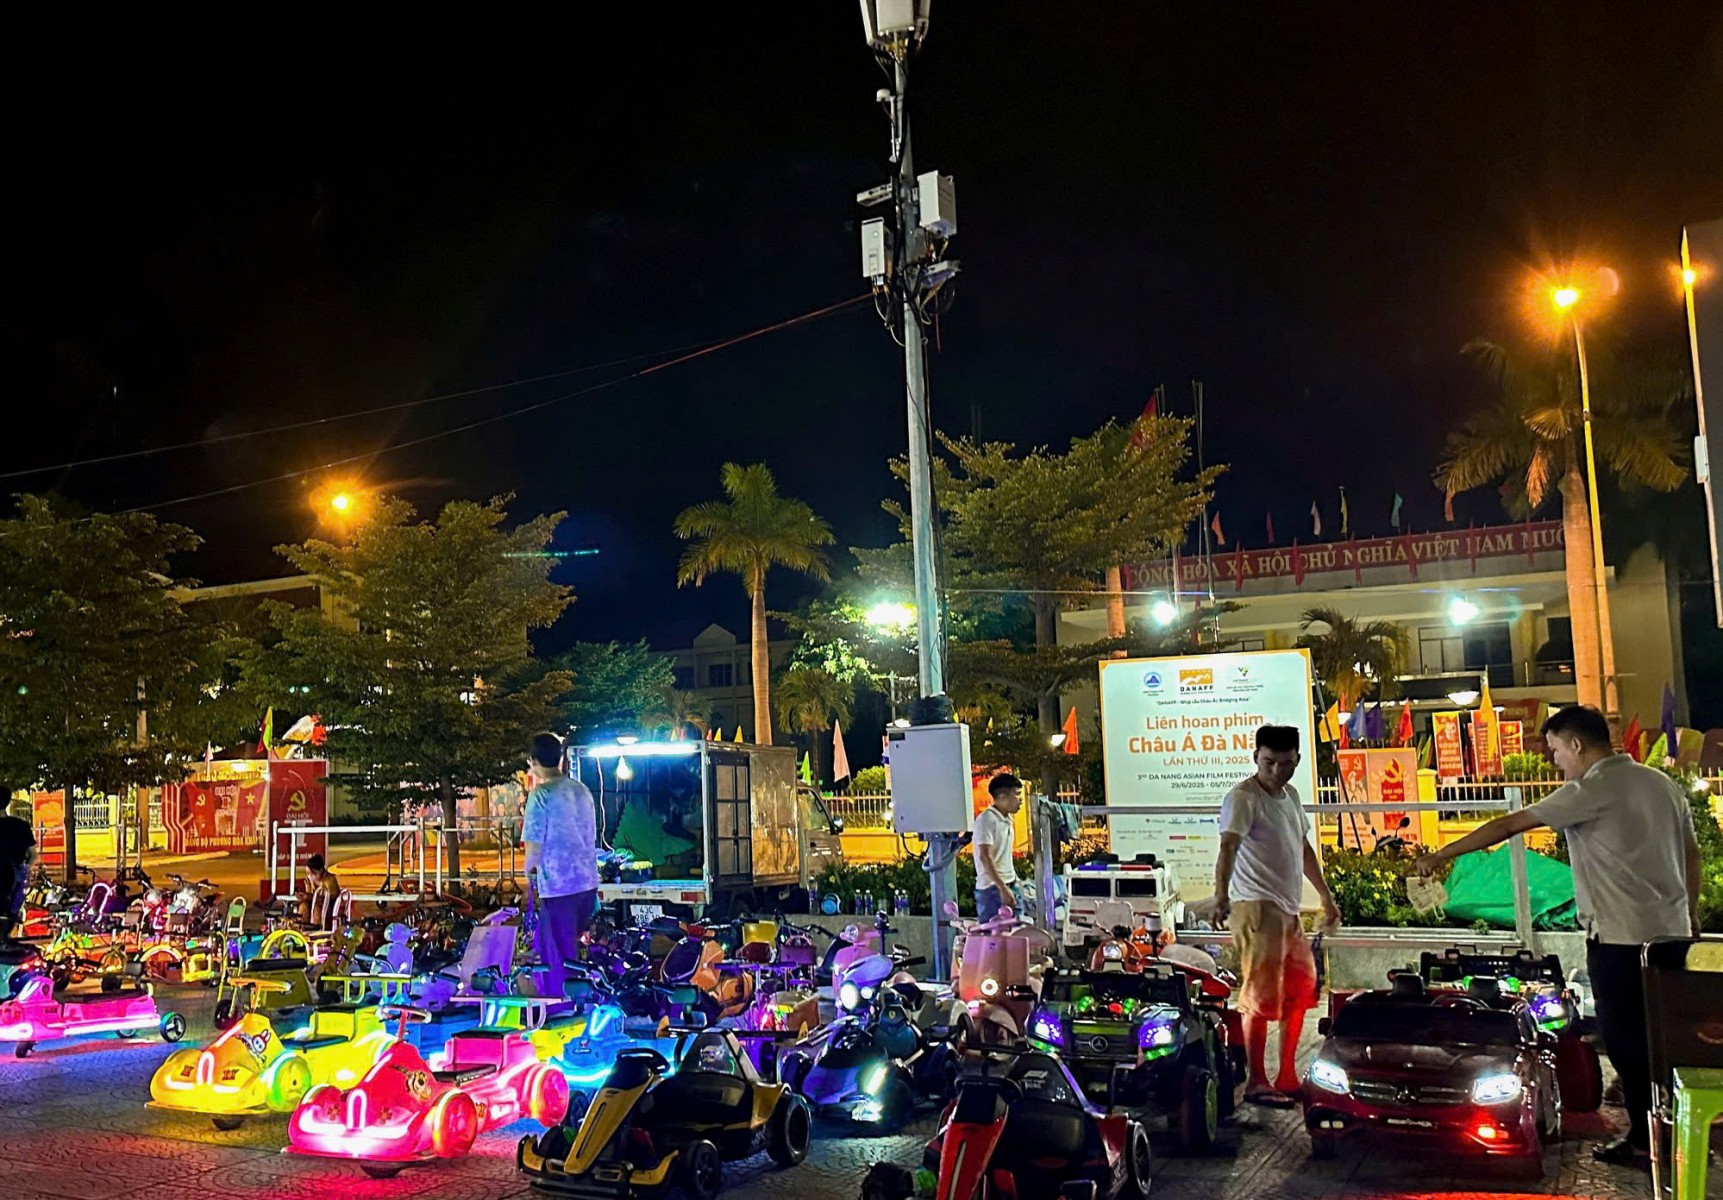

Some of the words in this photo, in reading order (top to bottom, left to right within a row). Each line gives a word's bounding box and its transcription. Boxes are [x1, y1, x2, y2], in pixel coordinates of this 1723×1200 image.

[1226, 554, 1253, 574] XÃ
[1258, 551, 1290, 575] HỘI
[1343, 540, 1409, 566] NGHĨA
[1411, 535, 1459, 562] VIỆT
[1146, 717, 1178, 730] Liên
[1182, 715, 1220, 729] hoan
[1224, 712, 1263, 730] phim
[1128, 736, 1176, 753] Châu
[1182, 732, 1196, 752] Á
[1201, 733, 1227, 751] Đà
[1226, 755, 1250, 765] 2025
[1225, 771, 1254, 779] FESTIVA
[1171, 781, 1205, 789] 29/6/2025
